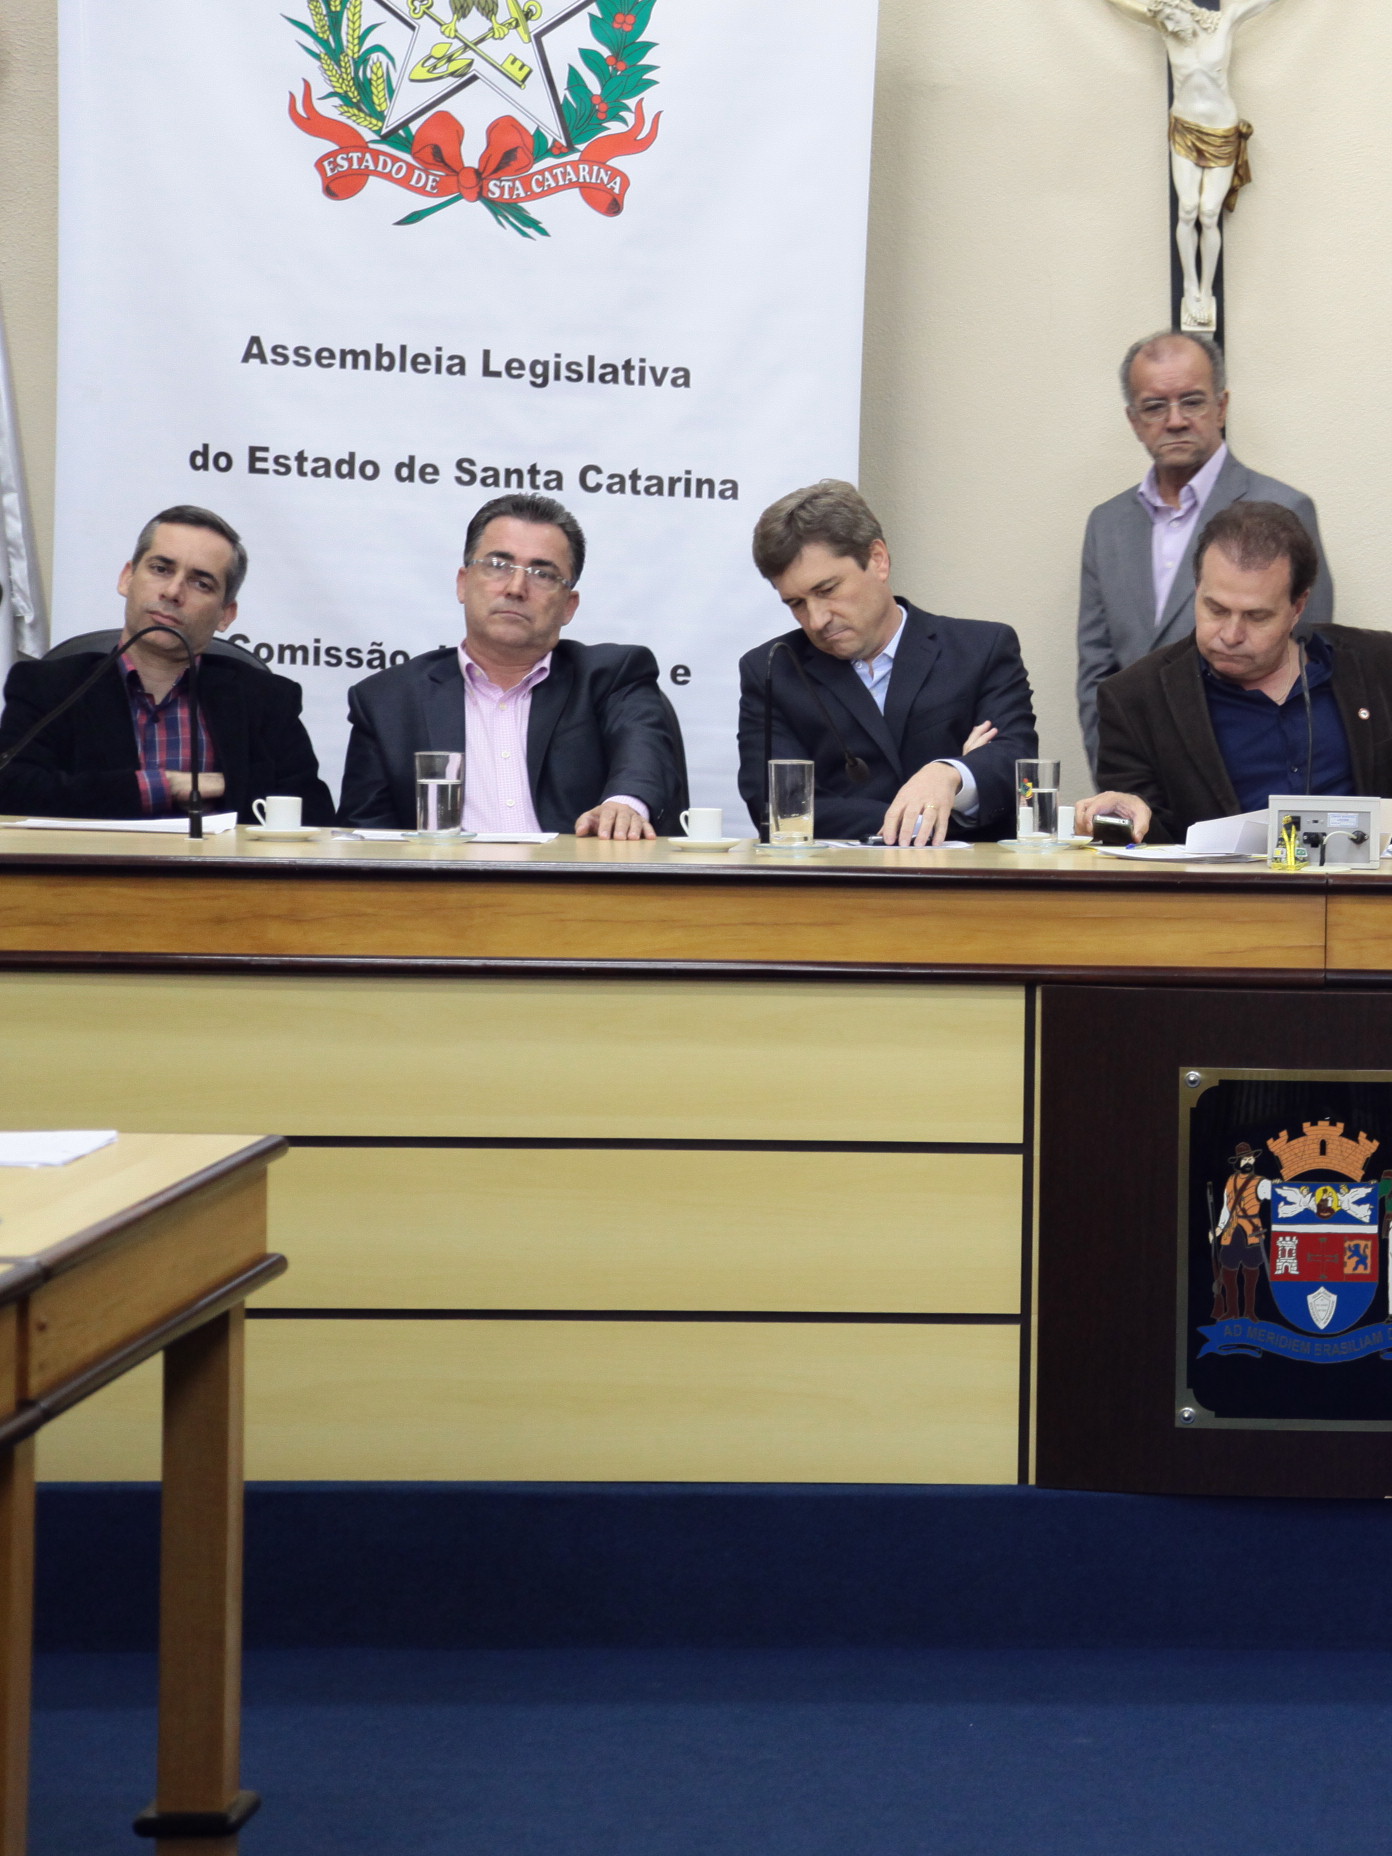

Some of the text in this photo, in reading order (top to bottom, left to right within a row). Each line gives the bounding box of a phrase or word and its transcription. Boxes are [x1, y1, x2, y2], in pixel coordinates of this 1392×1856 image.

[322, 151, 440, 194] ESTADO DE
[487, 161, 622, 200] STA. CATARINA
[240, 335, 692, 389] Assembleia Legislativa
[188, 442, 740, 501] do Estado de Santa Catarina
[1223, 1323, 1243, 1338] AD
